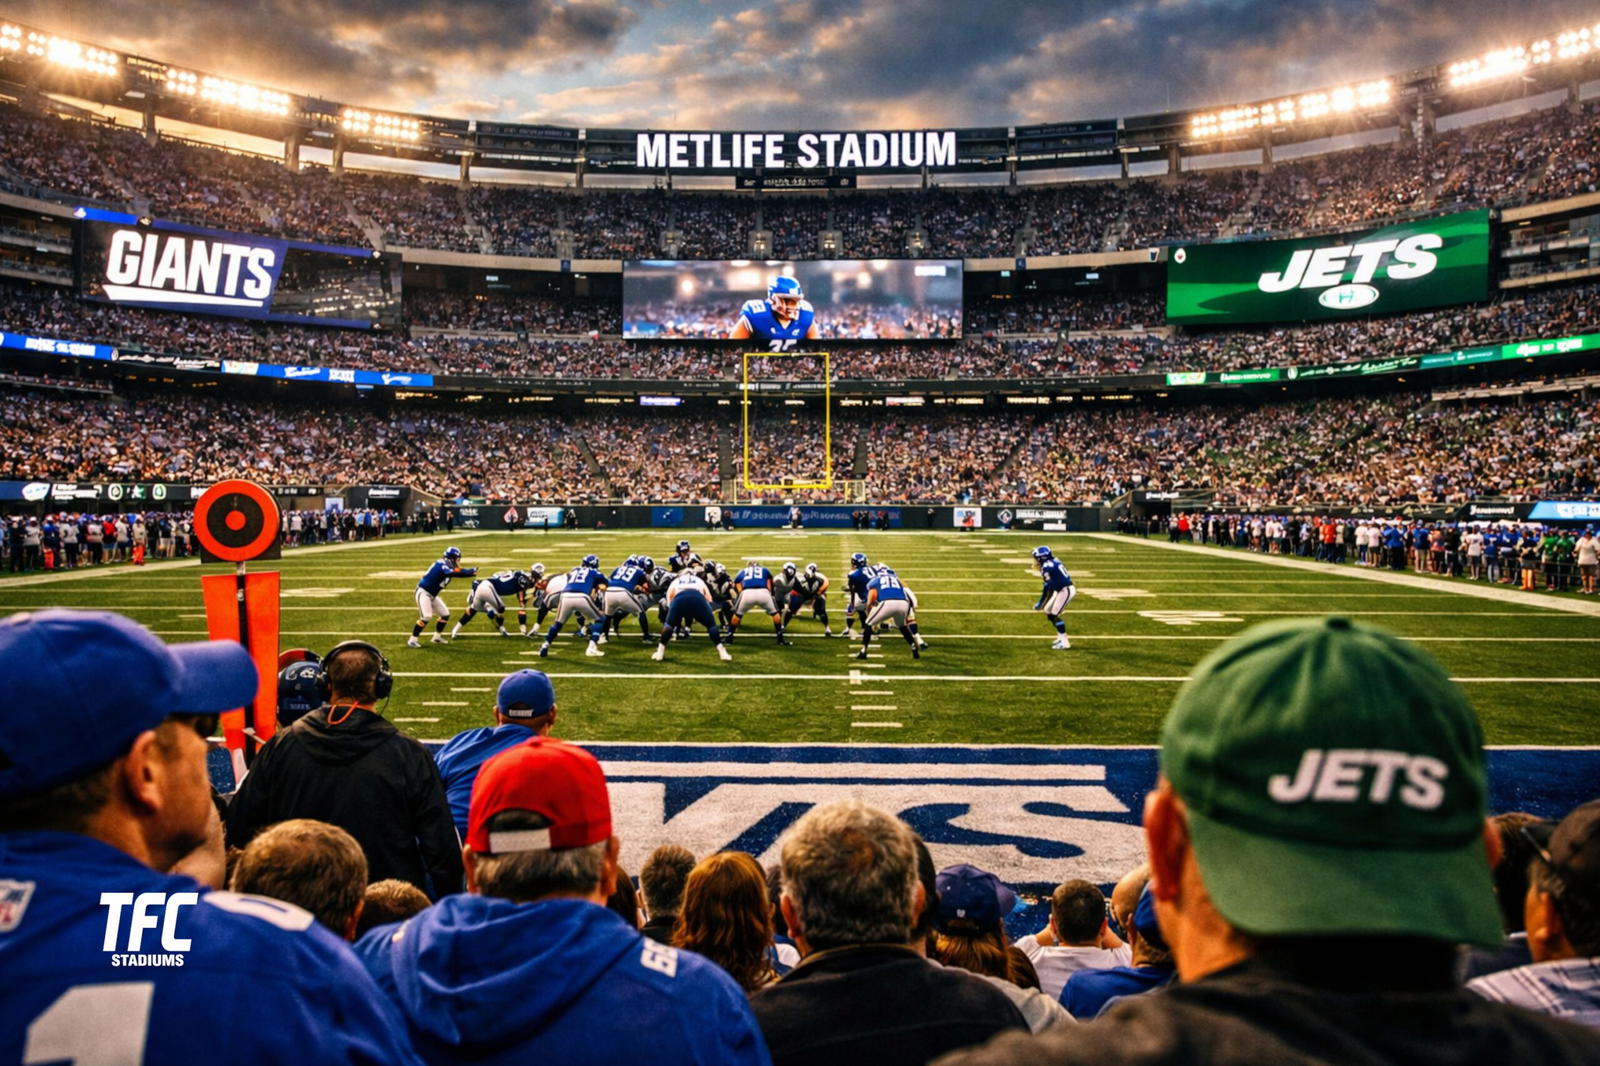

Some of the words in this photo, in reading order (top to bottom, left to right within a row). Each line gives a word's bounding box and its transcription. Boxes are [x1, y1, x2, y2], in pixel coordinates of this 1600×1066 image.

[636, 132, 786, 169] METLIFE
[797, 131, 957, 169] STADIUM
[106, 228, 276, 300] GIANTS
[1258, 232, 1443, 294] JETS
[1268, 748, 1450, 812] JETS
